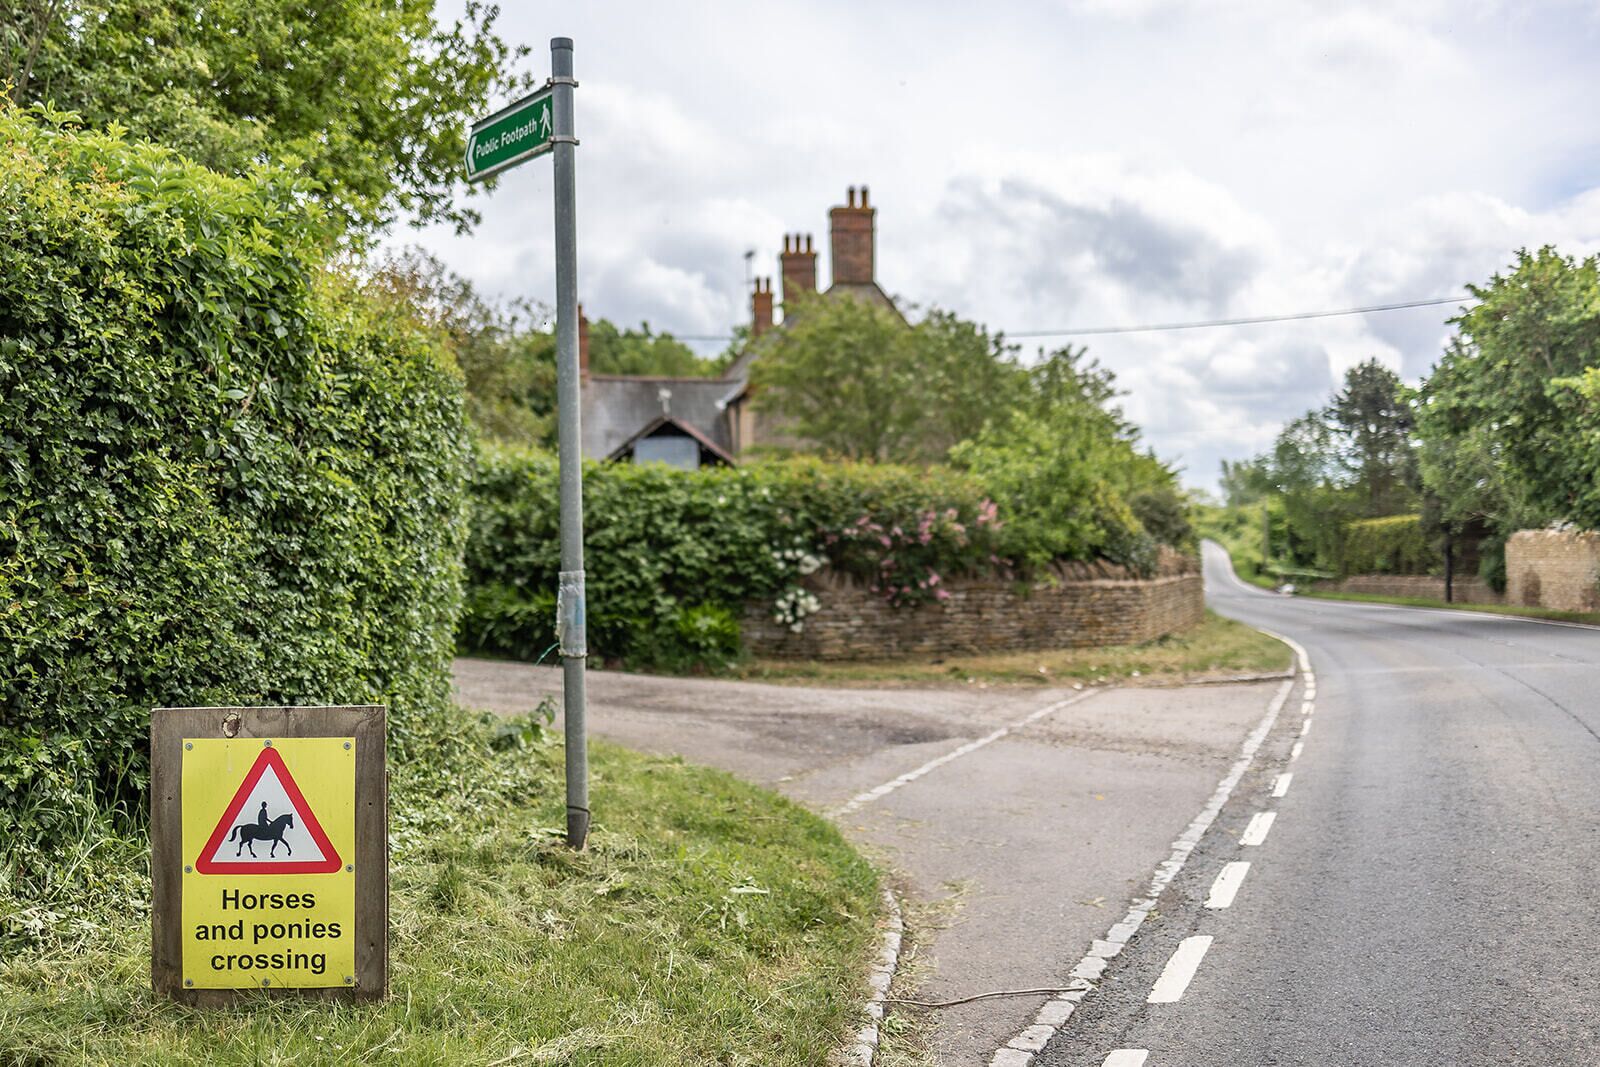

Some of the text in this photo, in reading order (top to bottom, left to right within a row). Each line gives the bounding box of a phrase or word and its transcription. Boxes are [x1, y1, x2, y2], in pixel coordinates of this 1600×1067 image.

[476, 118, 538, 159] Public Footpath
[222, 889, 316, 910] Horses
[195, 918, 342, 944] and ponies
[211, 949, 326, 975] crossing
